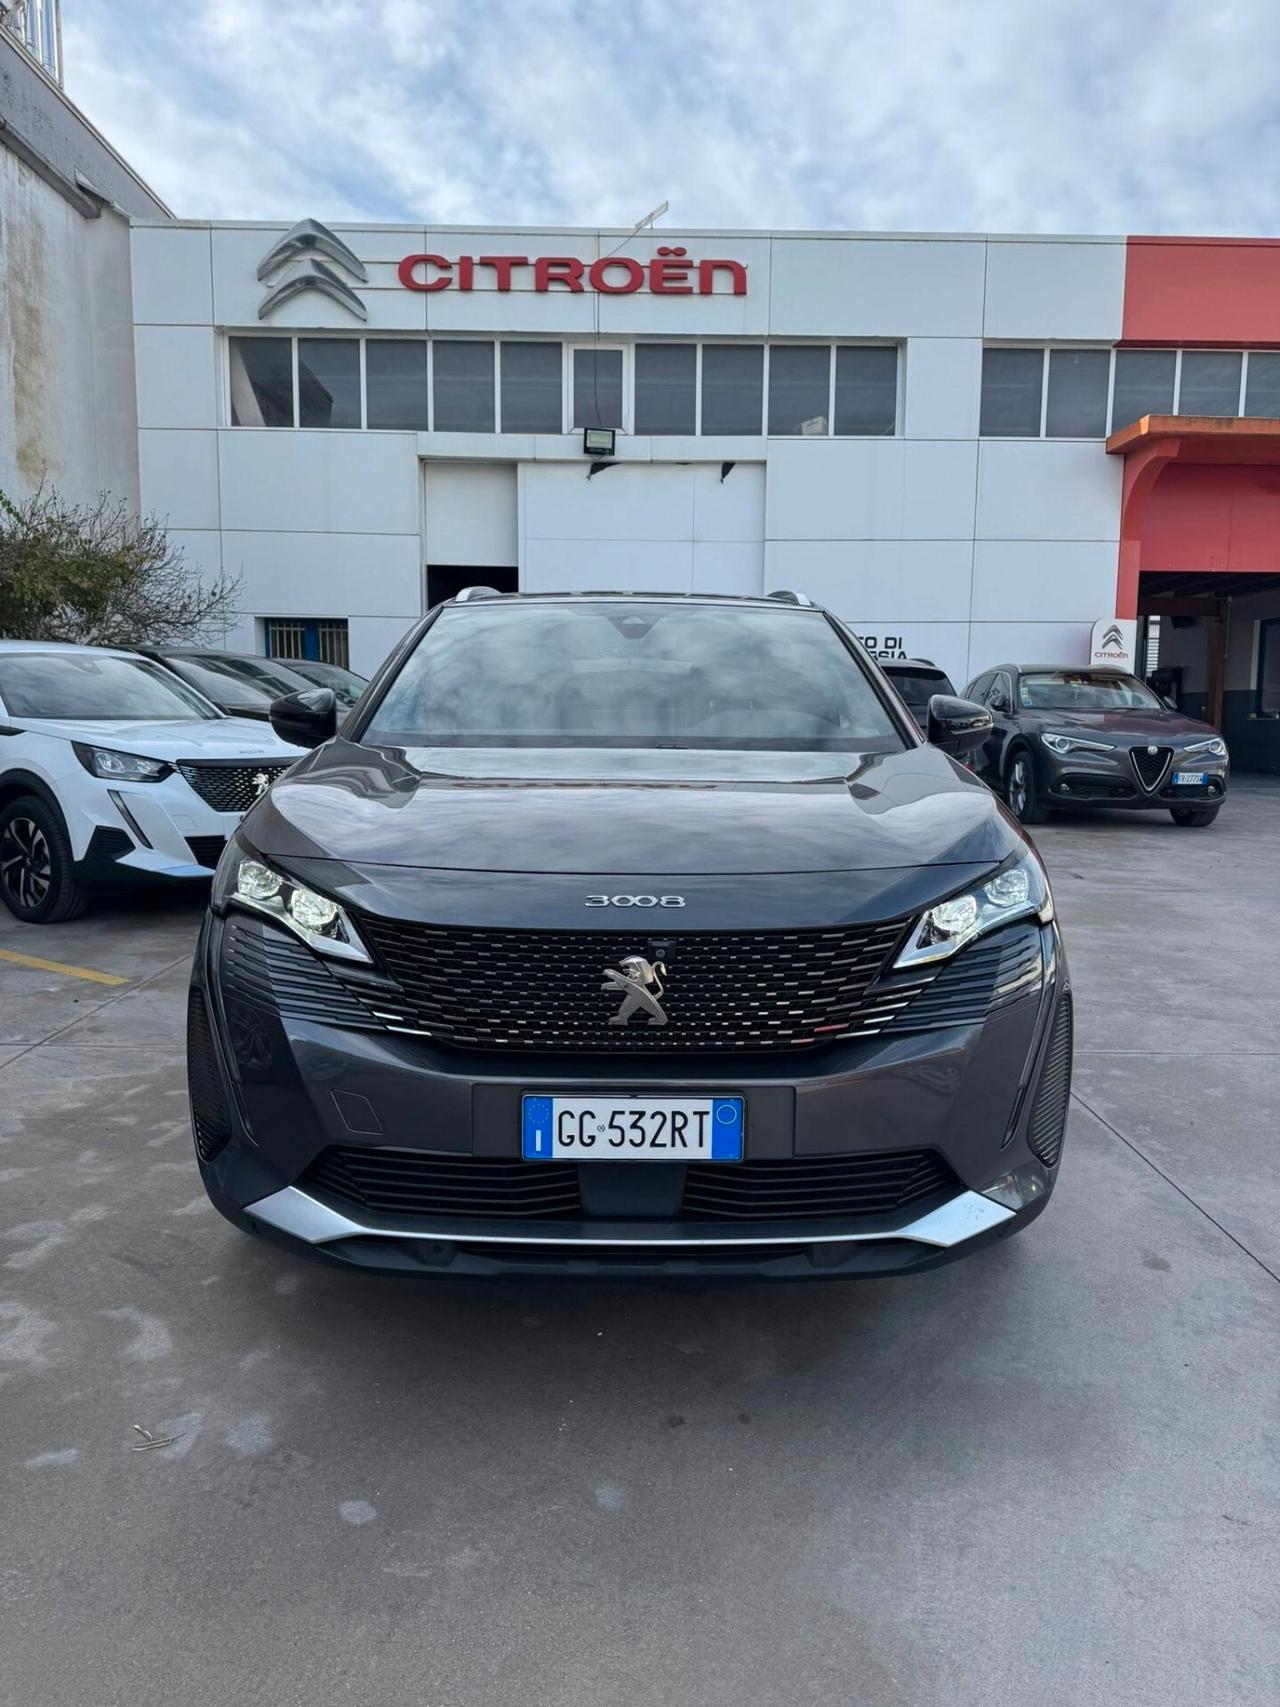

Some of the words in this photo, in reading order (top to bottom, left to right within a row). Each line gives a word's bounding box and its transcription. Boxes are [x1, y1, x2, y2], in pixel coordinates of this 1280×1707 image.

[858, 636, 877, 649] O
[884, 636, 902, 649] DI
[584, 895, 686, 908] 3008
